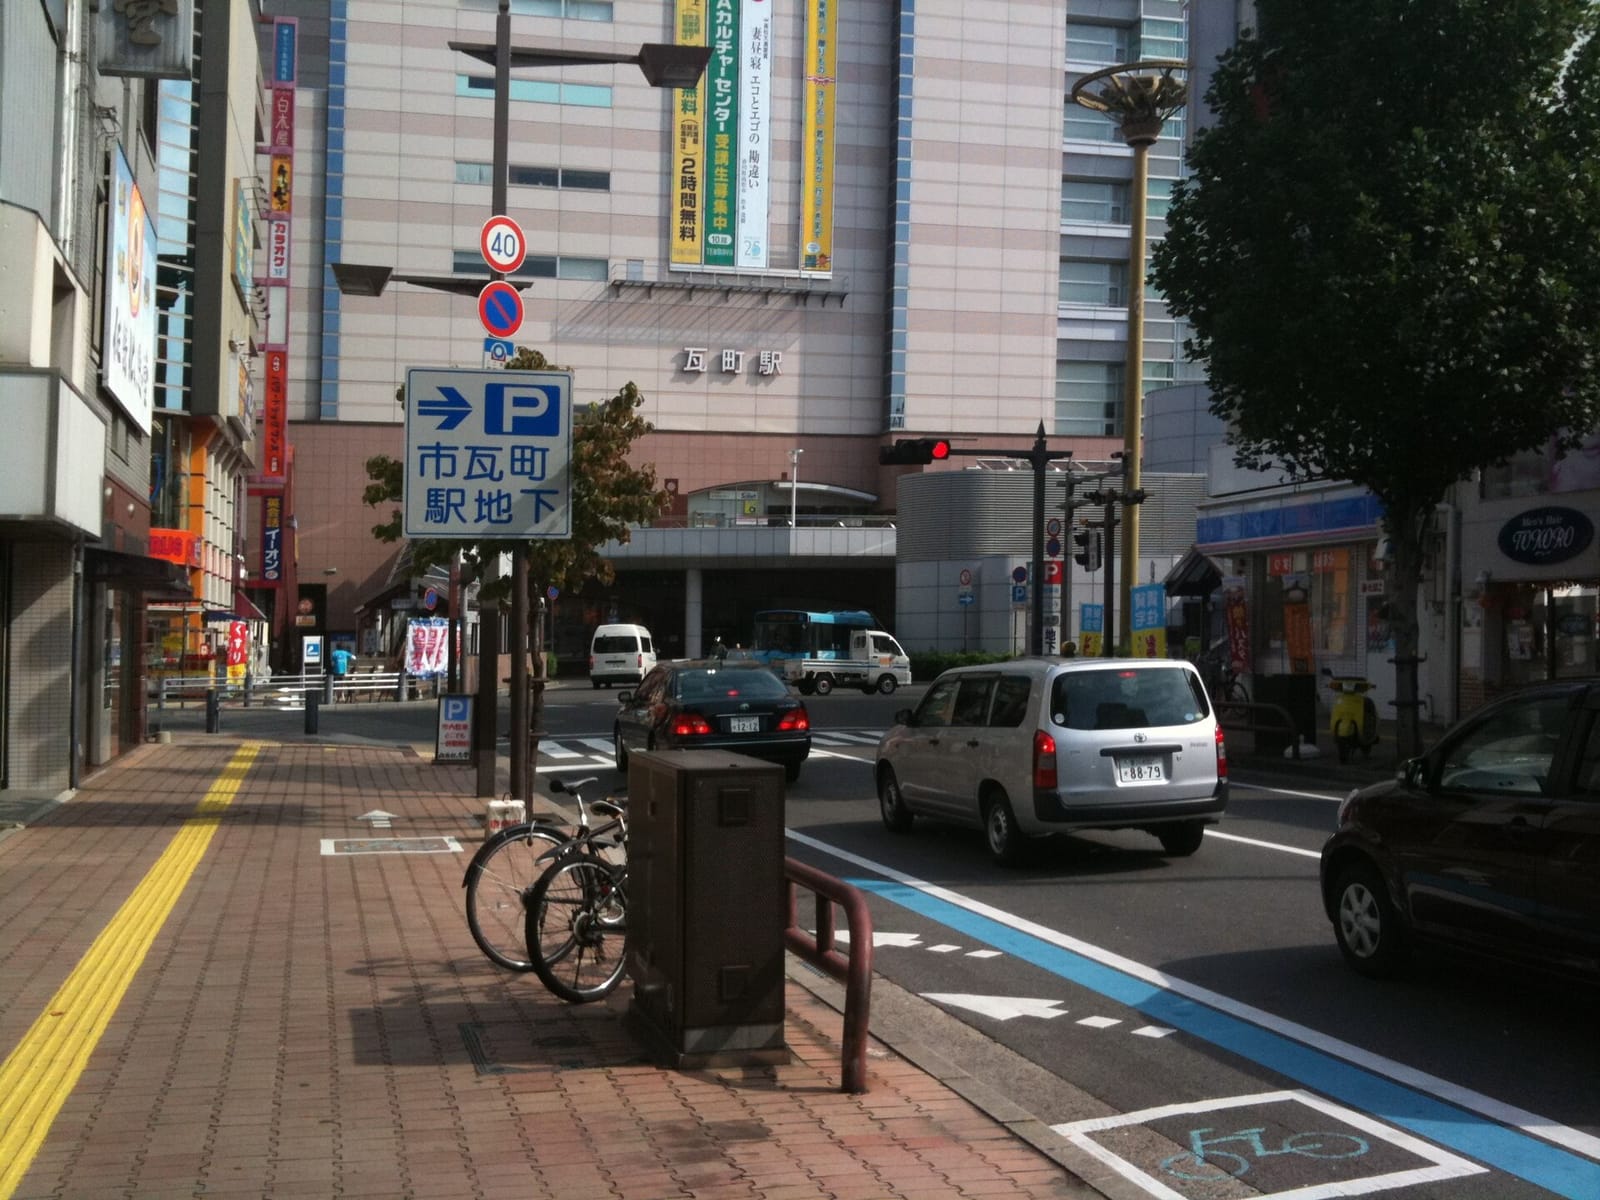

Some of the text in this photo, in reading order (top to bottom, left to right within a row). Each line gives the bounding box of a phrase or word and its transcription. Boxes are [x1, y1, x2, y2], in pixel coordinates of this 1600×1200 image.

[275, 96, 290, 146] 白木屋
[679, 158, 697, 242] 2時間無料
[273, 222, 286, 267] カラオケ
[491, 231, 516, 257] 40
[683, 347, 783, 375] 瓦町駅
[502, 386, 549, 433] P
[417, 442, 550, 482] 市瓦町
[424, 487, 560, 525] 駅地下
[265, 528, 280, 570] イーオン
[1044, 563, 1058, 581] P
[233, 625, 243, 664] くすり
[447, 699, 464, 720] P
[1130, 766, 1161, 779] 88-79
